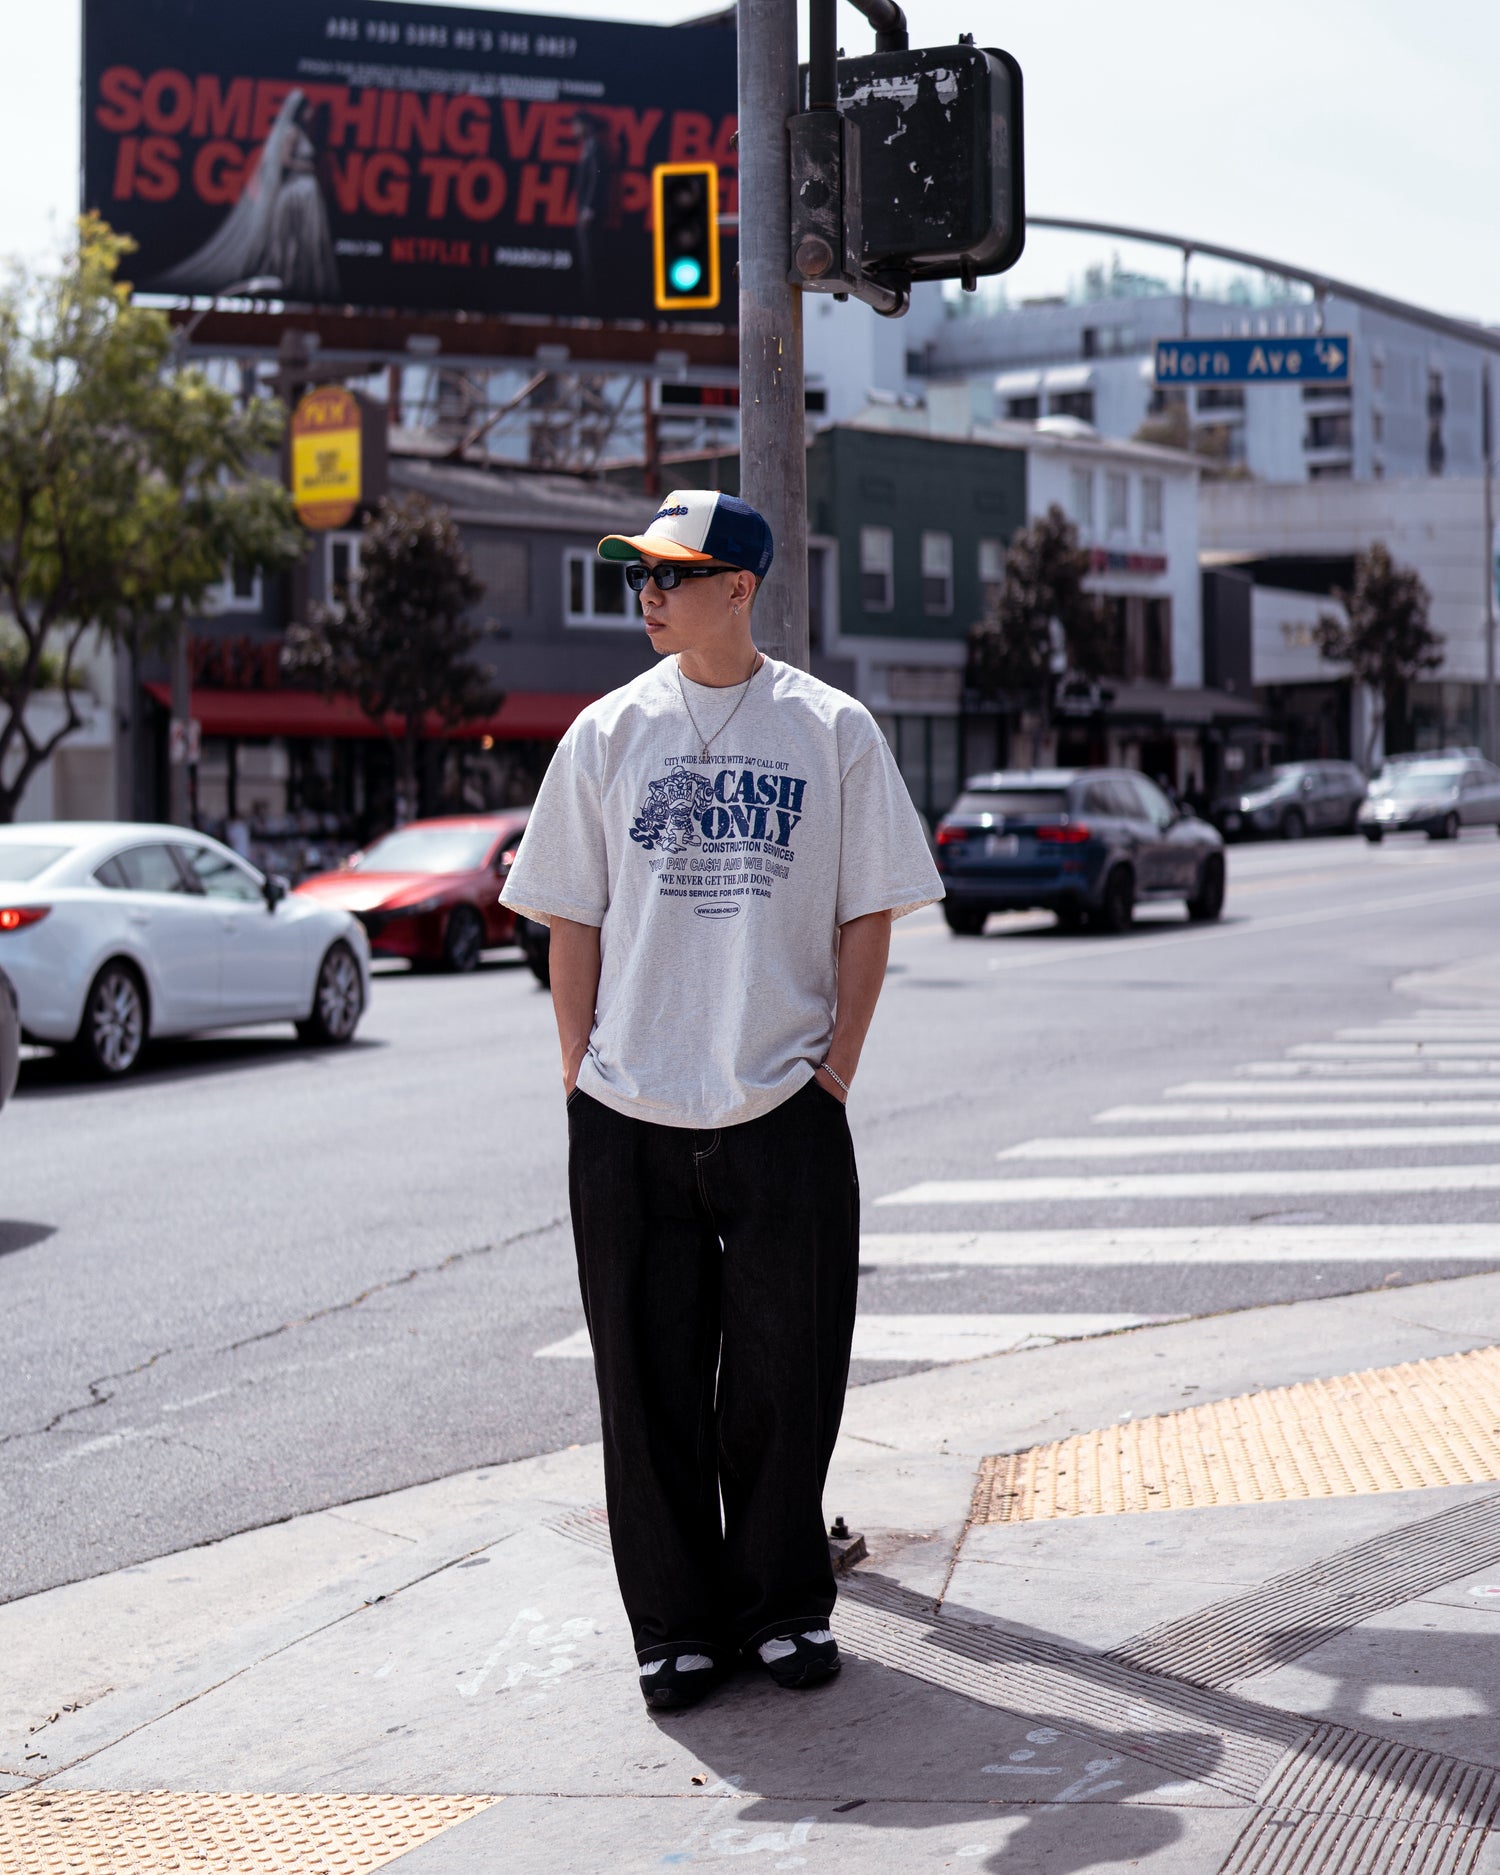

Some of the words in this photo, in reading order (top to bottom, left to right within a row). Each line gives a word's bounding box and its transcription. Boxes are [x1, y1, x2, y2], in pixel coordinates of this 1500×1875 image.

[113, 137, 182, 202] IS
[420, 157, 507, 221] TO
[390, 237, 471, 267] NETFLIX
[1158, 347, 1230, 376] Horn
[1247, 345, 1301, 374] Ave
[664, 756, 680, 766] CITY
[681, 755, 697, 764] WIDE
[727, 755, 744, 764] WITH
[757, 758, 774, 769] CALL
[775, 761, 789, 771] OUT
[714, 770, 807, 813] CASH
[701, 804, 801, 847] ONLY
[702, 840, 761, 853] CONSTRUCTION
[666, 857, 688, 871] PAY
[744, 857, 763, 870] WE
[676, 875, 703, 886] NEVER
[705, 875, 722, 886] GET
[723, 875, 736, 886] THE
[737, 873, 749, 885] JOB
[660, 888, 688, 898] FAMOUS
[689, 889, 718, 898] SERVICE
[719, 889, 732, 898] FOR
[745, 887, 751, 896] 6
[751, 887, 773, 898] YEARS
